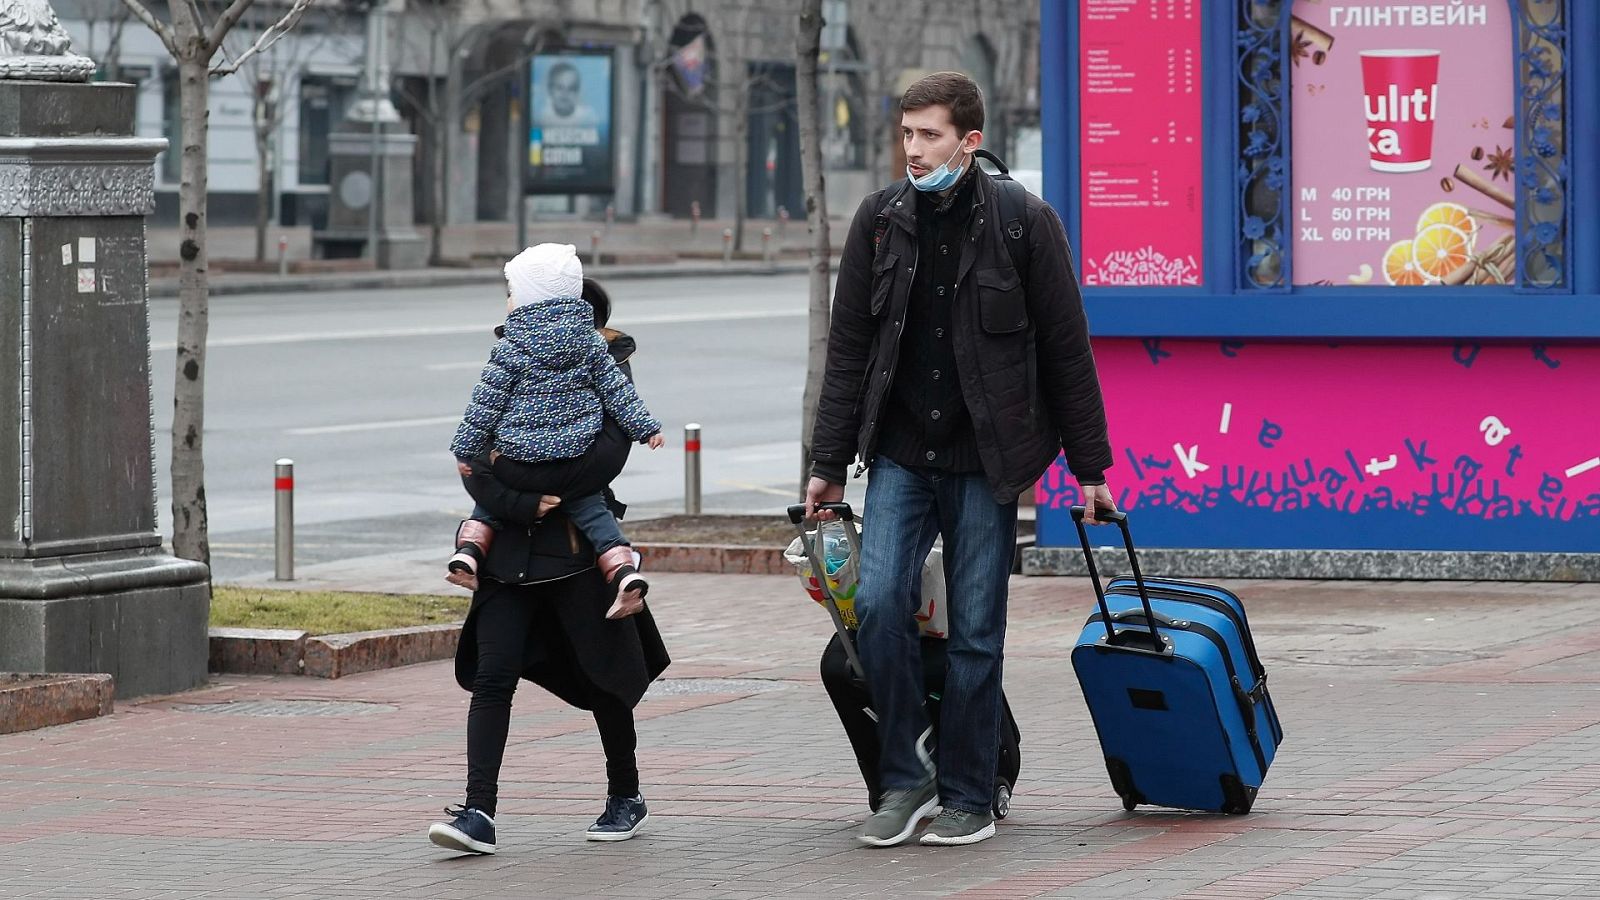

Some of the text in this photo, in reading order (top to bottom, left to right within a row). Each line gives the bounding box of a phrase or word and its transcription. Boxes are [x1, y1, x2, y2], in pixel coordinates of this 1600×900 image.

[1330, 0, 1487, 26] ГЛІНТВЕЙН
[1301, 187, 1391, 201] M 40 ГРН
[1301, 207, 1391, 221] L 50 ГРН
[1301, 227, 1391, 241] XL 60 ГРН
